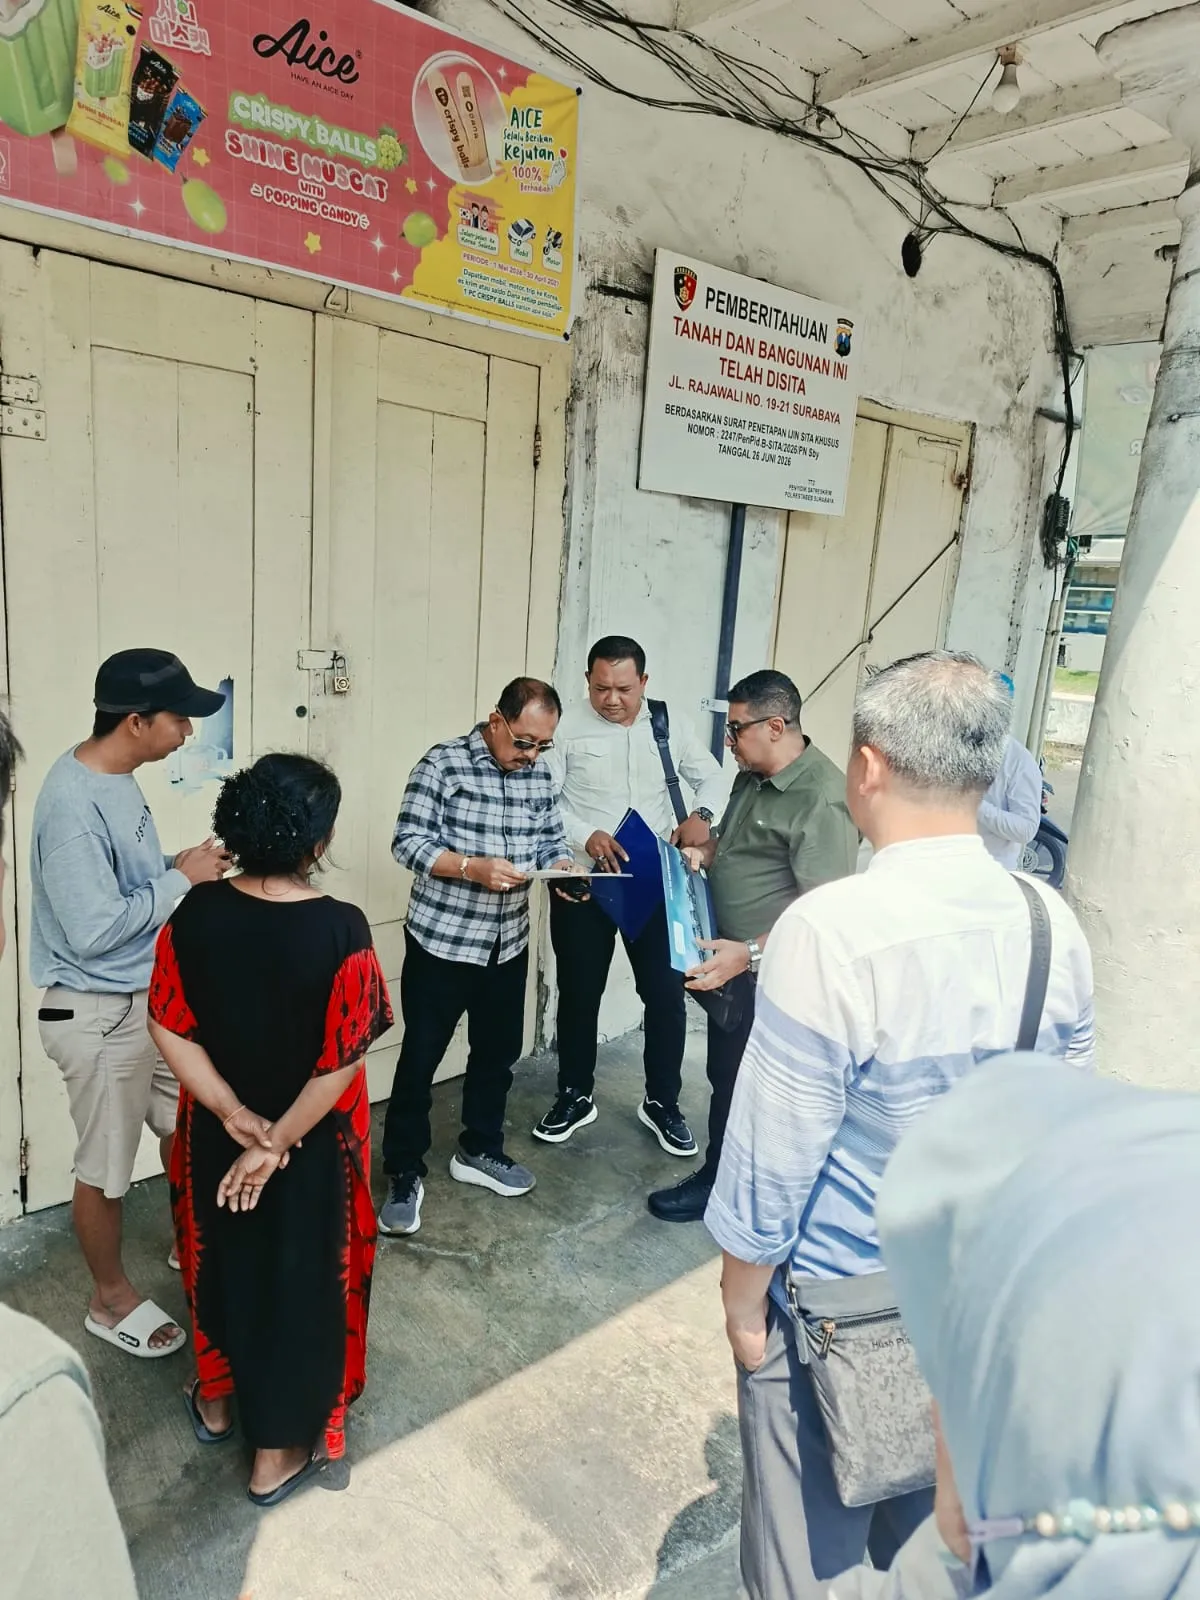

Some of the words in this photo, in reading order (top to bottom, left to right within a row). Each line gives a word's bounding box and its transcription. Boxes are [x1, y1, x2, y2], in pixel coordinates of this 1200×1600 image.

[253, 19, 359, 84] Aice
[503, 128, 524, 141] Selalu
[526, 131, 553, 143] Berikan
[510, 107, 543, 129] AICE
[315, 121, 377, 161] BALLS
[444, 108, 461, 142] crispy
[457, 144, 470, 169] balls
[504, 142, 554, 165] Kejutan
[227, 131, 298, 173] SHINE
[302, 153, 388, 200] MUSCAT
[512, 166, 542, 181] 100%
[265, 187, 319, 214] POPPING
[320, 203, 359, 226] CANDY
[300, 181, 325, 198] WITH
[477, 292, 497, 302] CRISPY
[497, 297, 515, 307] BALLS
[705, 286, 828, 344] PEMBERITAHUAN
[673, 316, 722, 347] TANAH
[725, 330, 755, 356] DAN
[758, 340, 831, 376] BANGUNAN
[833, 361, 848, 381] INI
[719, 357, 763, 386] TELAH
[766, 369, 806, 396] DISITA
[668, 374, 685, 390] JL.
[688, 378, 743, 403] RAJAWALI
[745, 391, 763, 408] NO.
[766, 397, 790, 413] 19-21
[792, 403, 840, 424] SURABAYA
[665, 403, 722, 425] BERDASARKAN
[723, 415, 747, 430] SURAT
[747, 420, 787, 438] PENETAPAN
[800, 432, 814, 443] SITA
[815, 434, 839, 448] KHUSUS
[687, 422, 715, 438] NOMOR
[808, 447, 819, 461] Sby
[718, 443, 751, 459] TANGGAL
[752, 450, 760, 461] 26
[761, 452, 776, 464] JUNI
[777, 455, 791, 466] 2026
